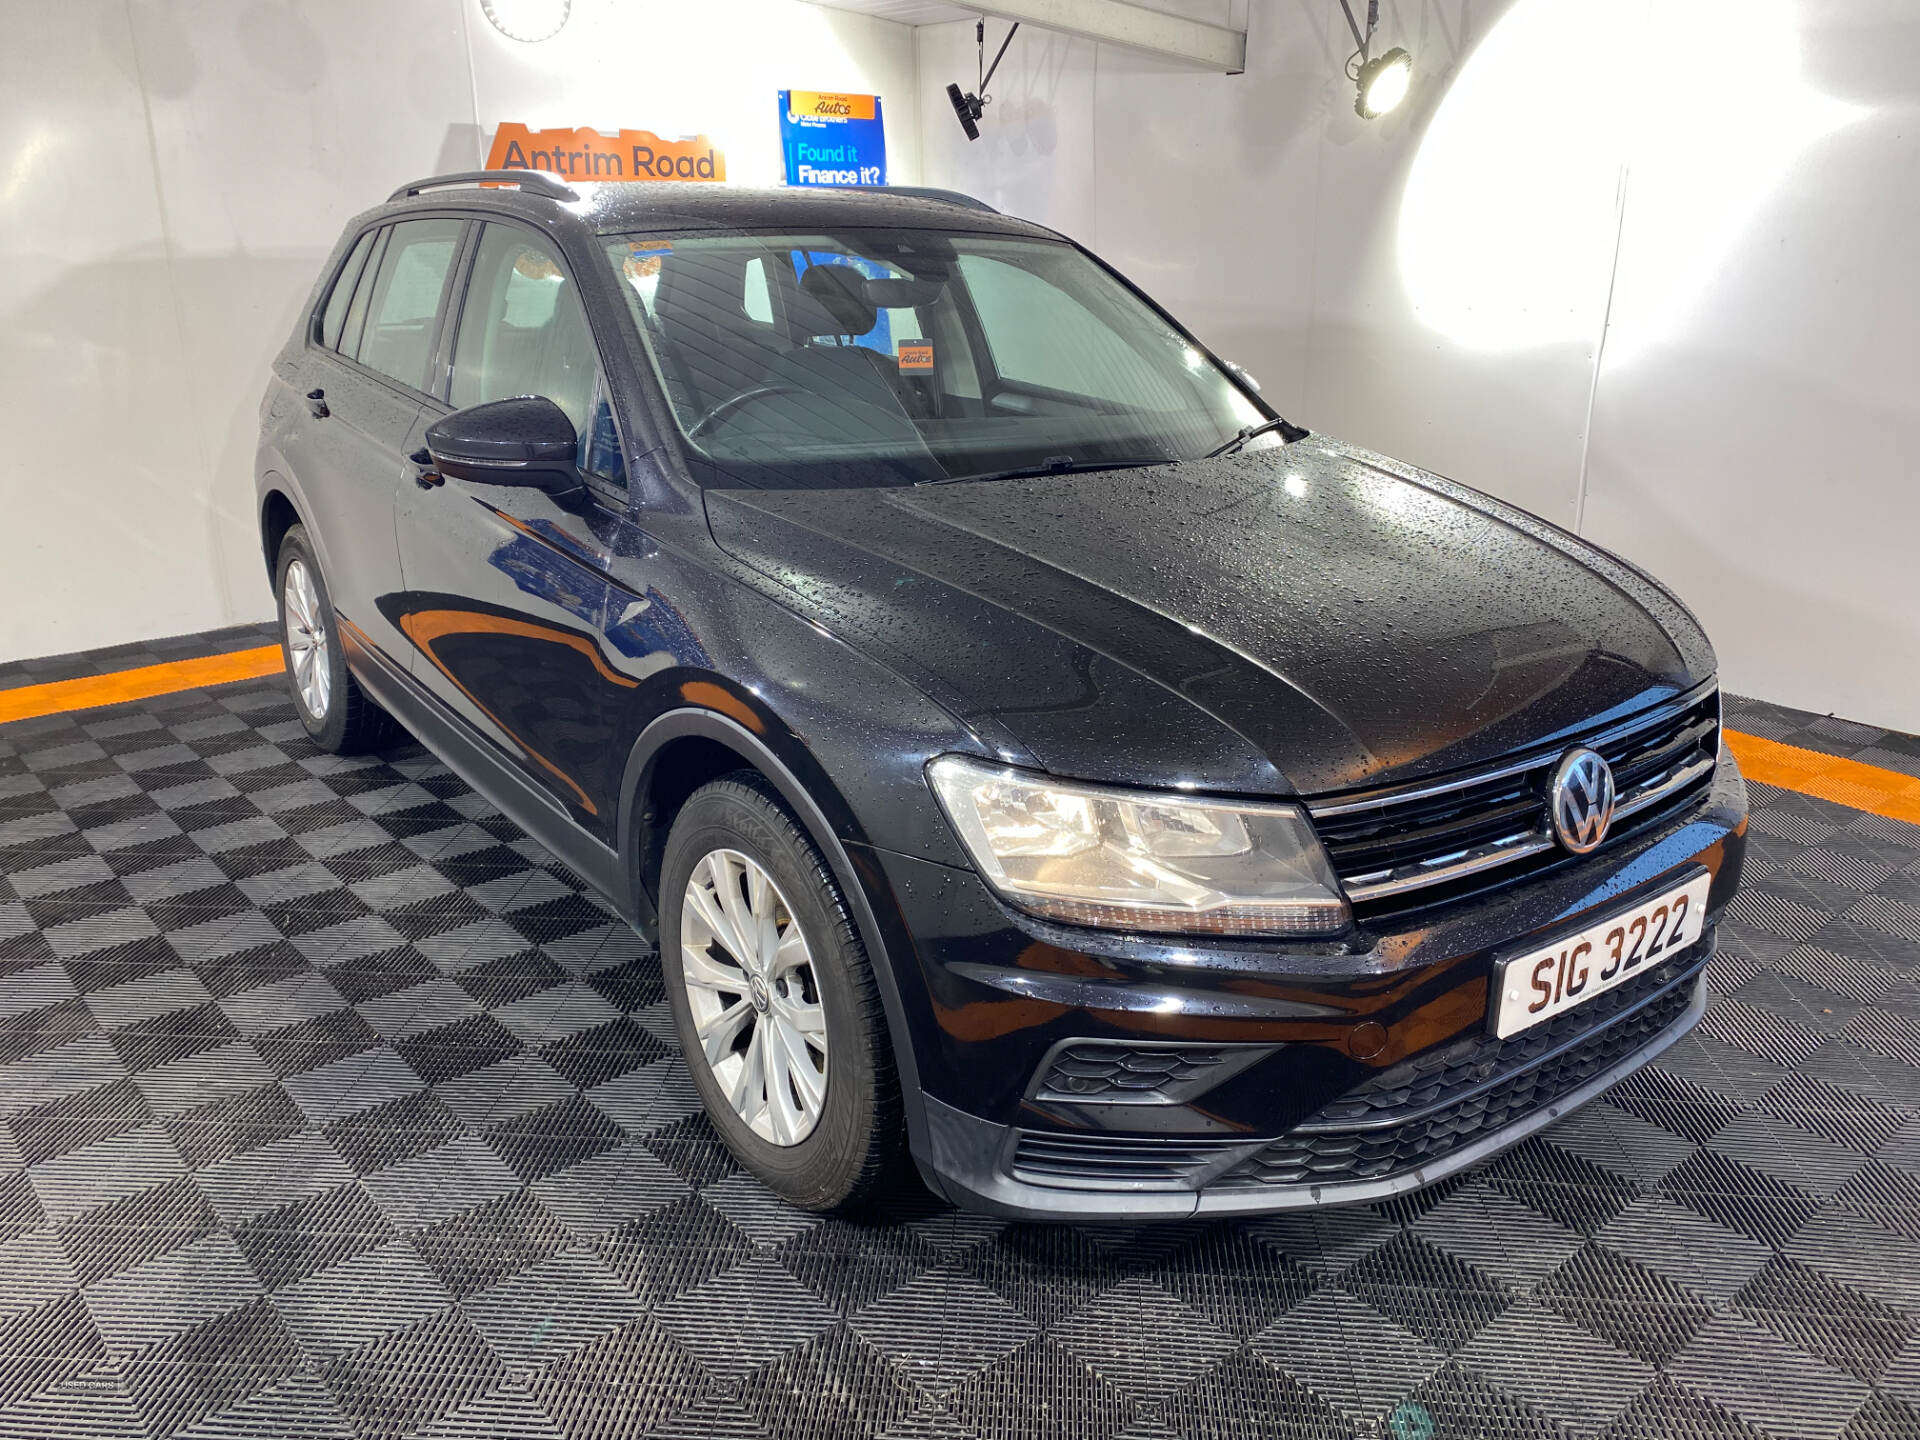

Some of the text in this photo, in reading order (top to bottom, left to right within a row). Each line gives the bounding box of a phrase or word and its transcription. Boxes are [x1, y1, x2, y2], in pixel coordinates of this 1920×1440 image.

[814, 101, 852, 115] Autos
[502, 140, 716, 179] Antrim Road
[797, 143, 858, 162] Found it
[798, 165, 880, 185] Finance it?
[1527, 941, 1593, 1014] SIG
[1600, 894, 1690, 982] 3222
